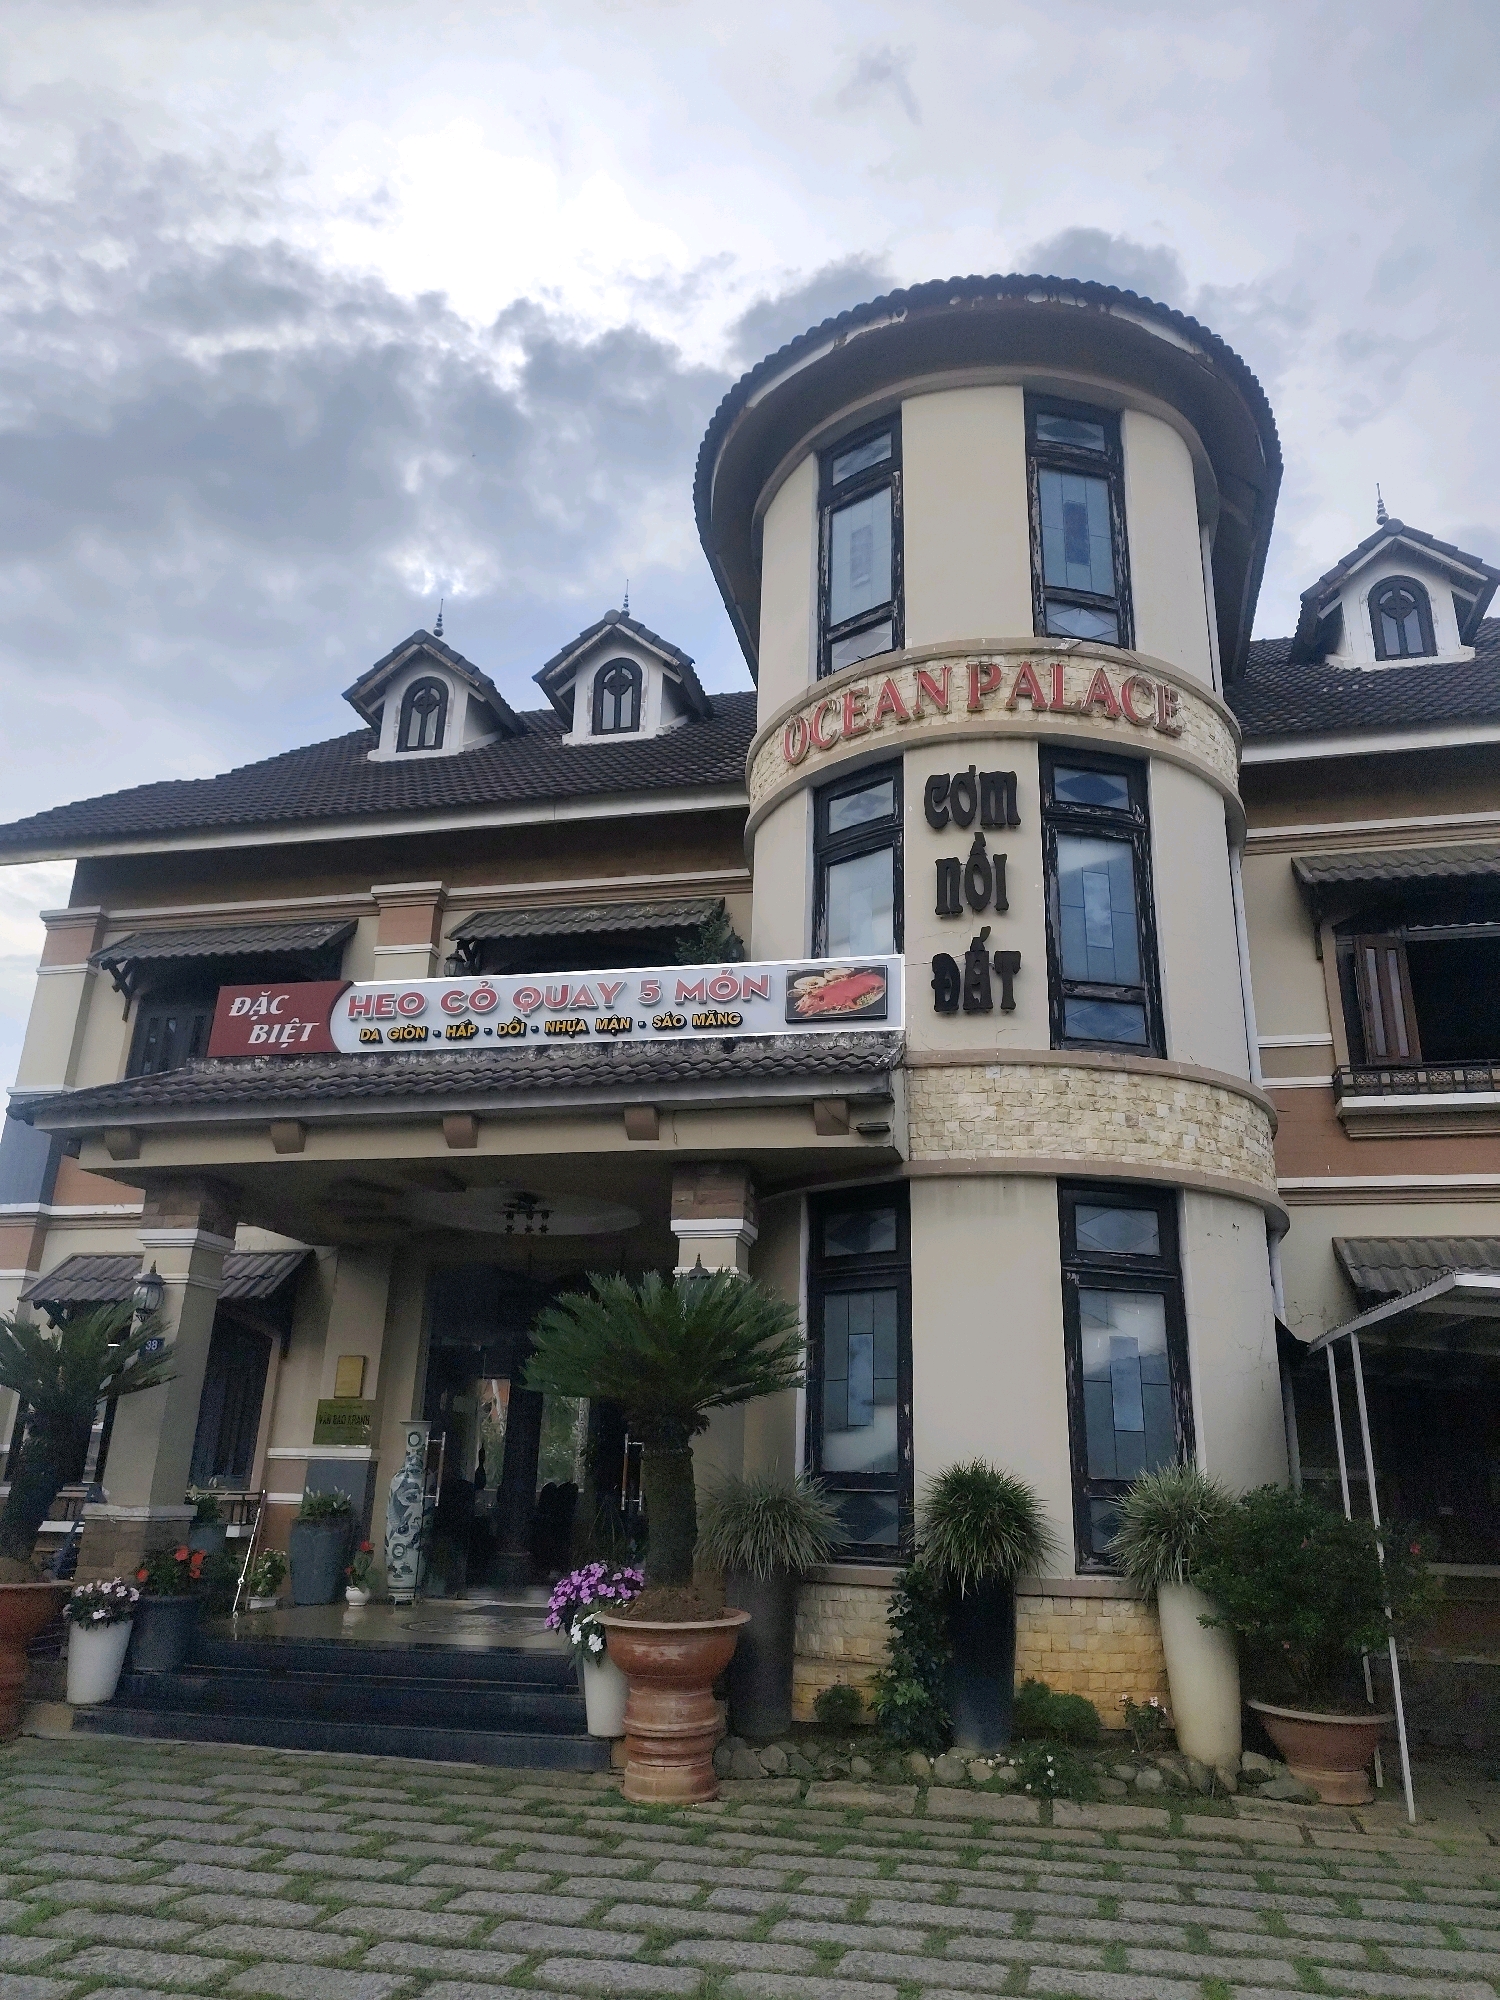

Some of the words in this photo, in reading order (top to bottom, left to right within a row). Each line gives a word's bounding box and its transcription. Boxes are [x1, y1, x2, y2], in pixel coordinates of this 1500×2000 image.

[782, 664, 953, 765] OCEAN
[966, 660, 1184, 738] PALACE
[229, 991, 289, 1020] ĐẶC
[347, 991, 428, 1020] HEO
[440, 980, 499, 1016] CỎ
[511, 980, 626, 1017] QUAY
[637, 979, 662, 1006] 5
[675, 968, 772, 1005] MÓN
[248, 1018, 319, 1048] BIỆT
[359, 1028, 383, 1043] DA
[387, 1024, 428, 1042] GIÒN
[445, 1018, 479, 1039] HẤP
[544, 1018, 590, 1038] NHỰA
[595, 1014, 633, 1036] MẬN
[652, 1012, 687, 1031] SÁO
[692, 1010, 743, 1029] MĂNG
[145, 1340, 158, 1350] 38
